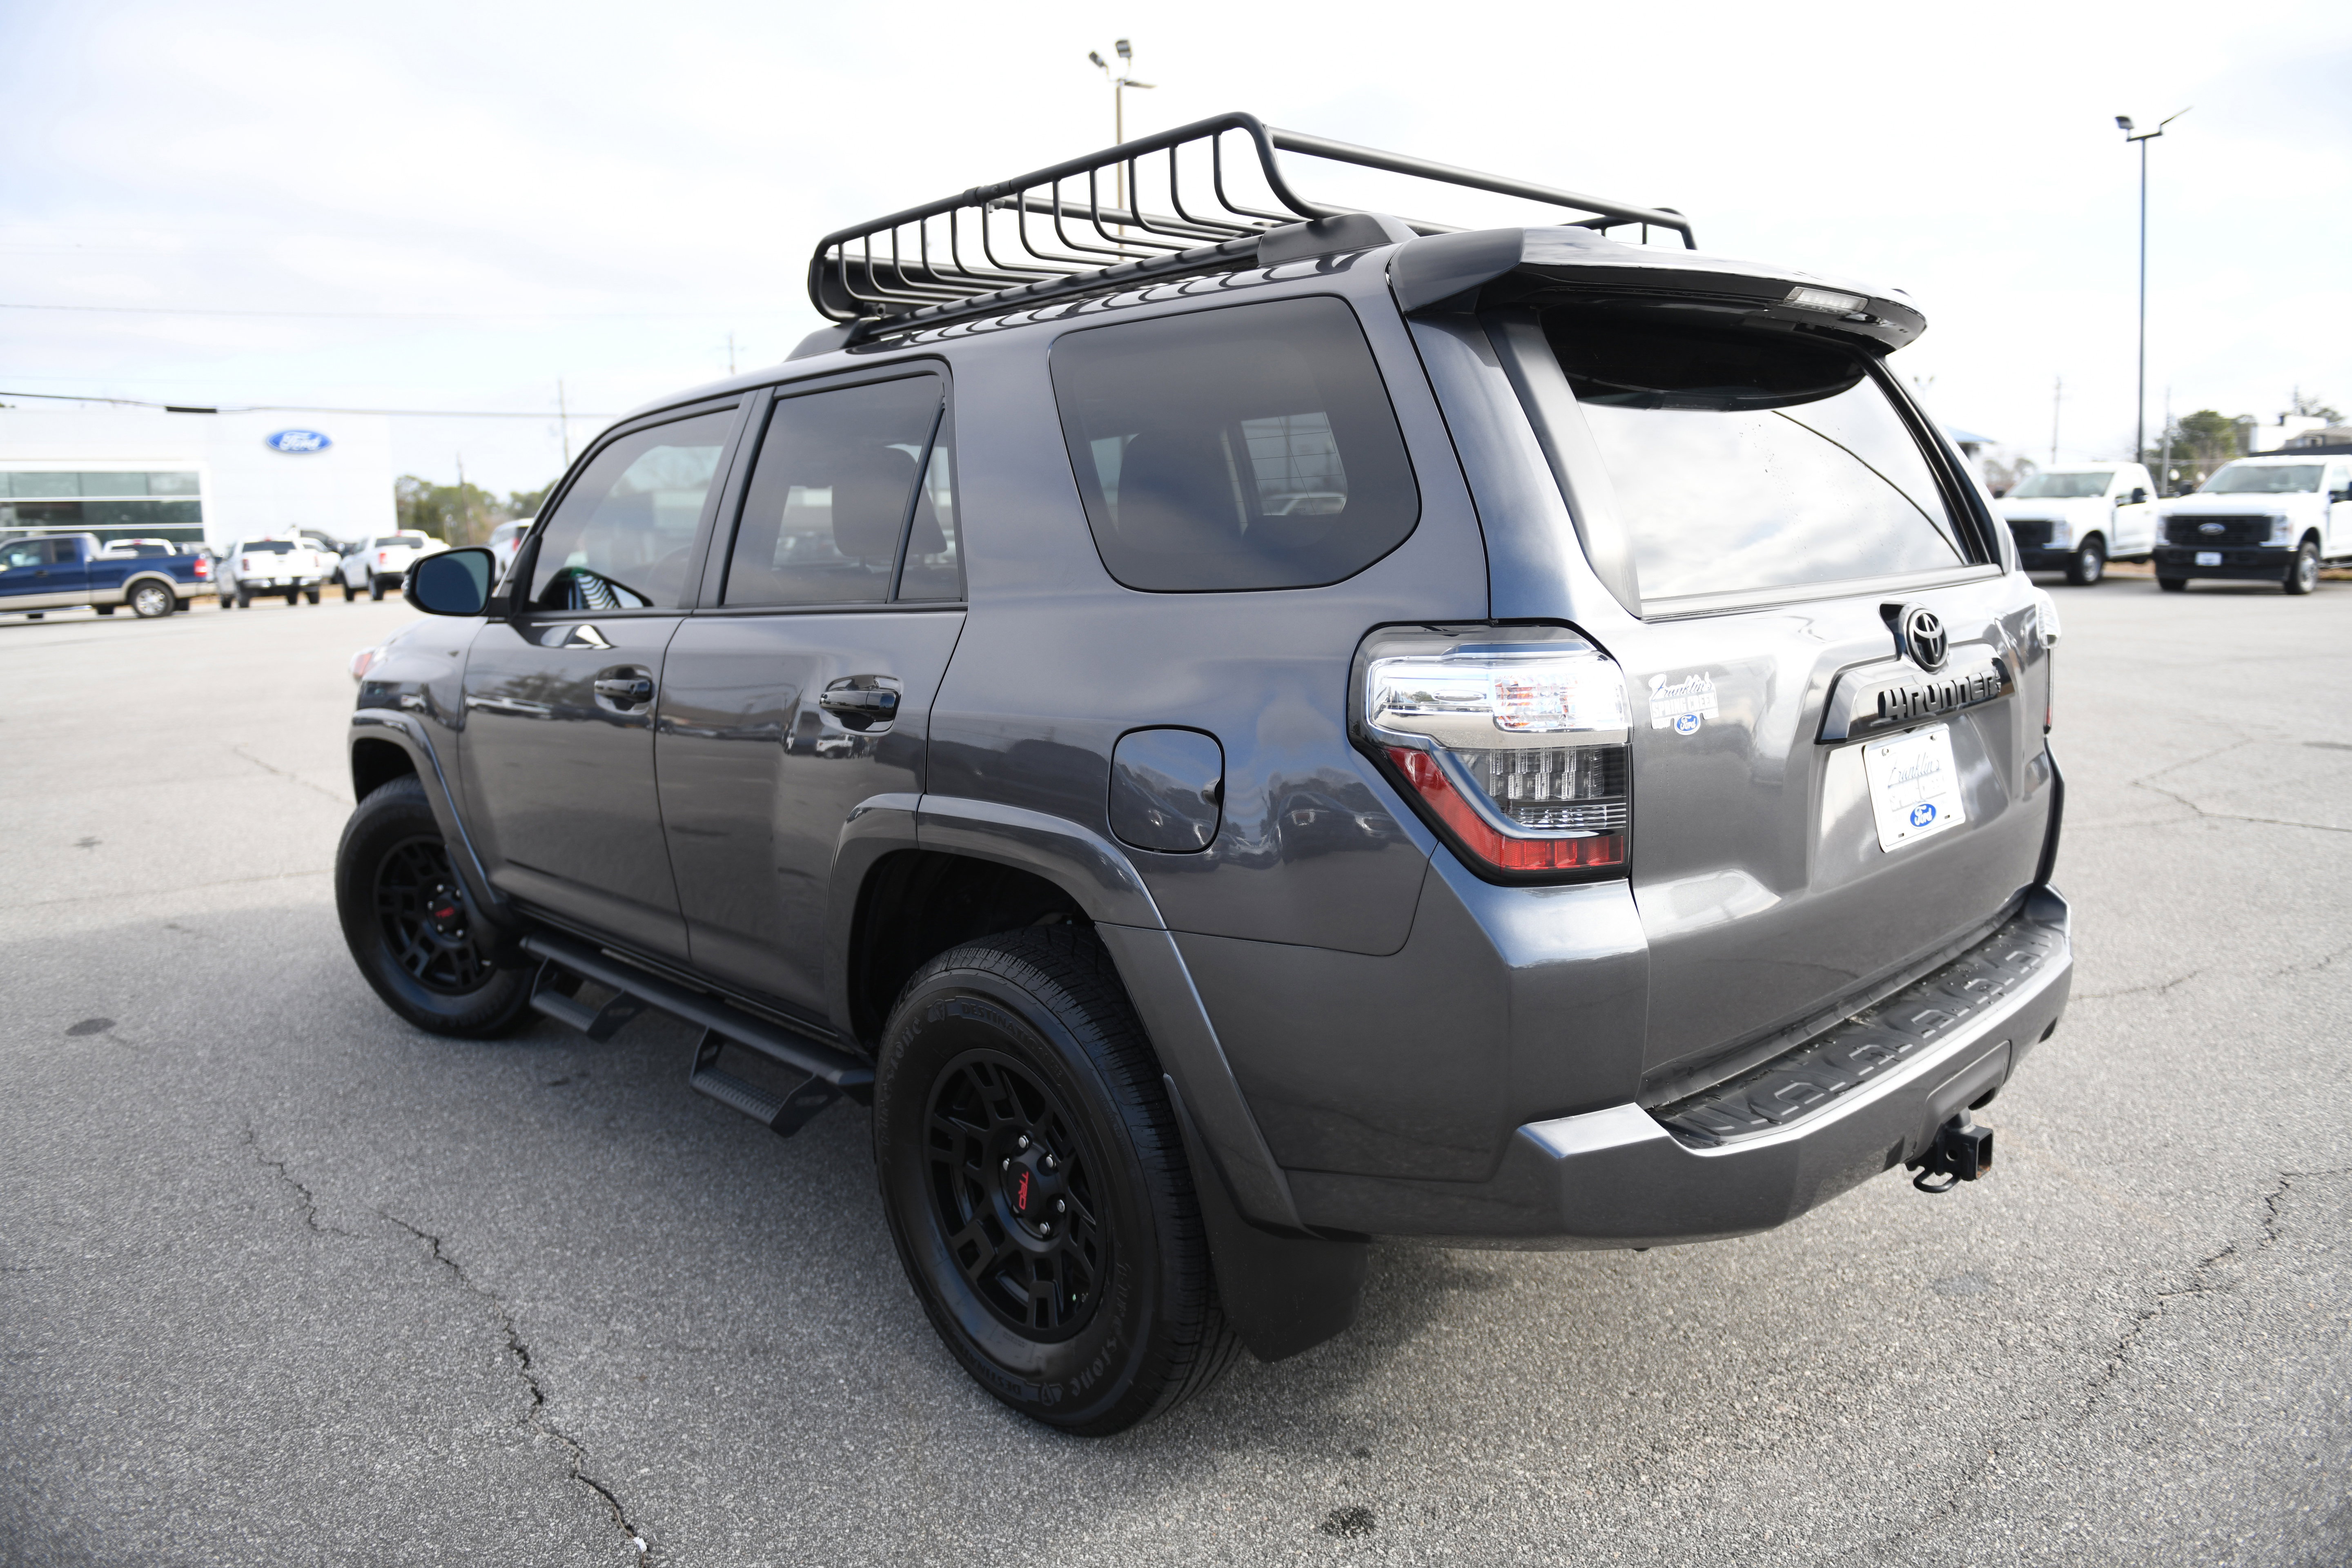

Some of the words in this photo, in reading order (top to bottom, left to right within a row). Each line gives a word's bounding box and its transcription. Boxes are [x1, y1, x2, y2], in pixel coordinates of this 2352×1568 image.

[279, 432, 322, 451] Ford
[1652, 697, 1687, 718] SPRING
[1687, 692, 1717, 711] CREEK
[1680, 715, 1697, 730] Ford
[1914, 805, 1933, 826] Ford
[961, 1002, 1048, 1060] DESTINATION
[1018, 1171, 1029, 1210] TRD
